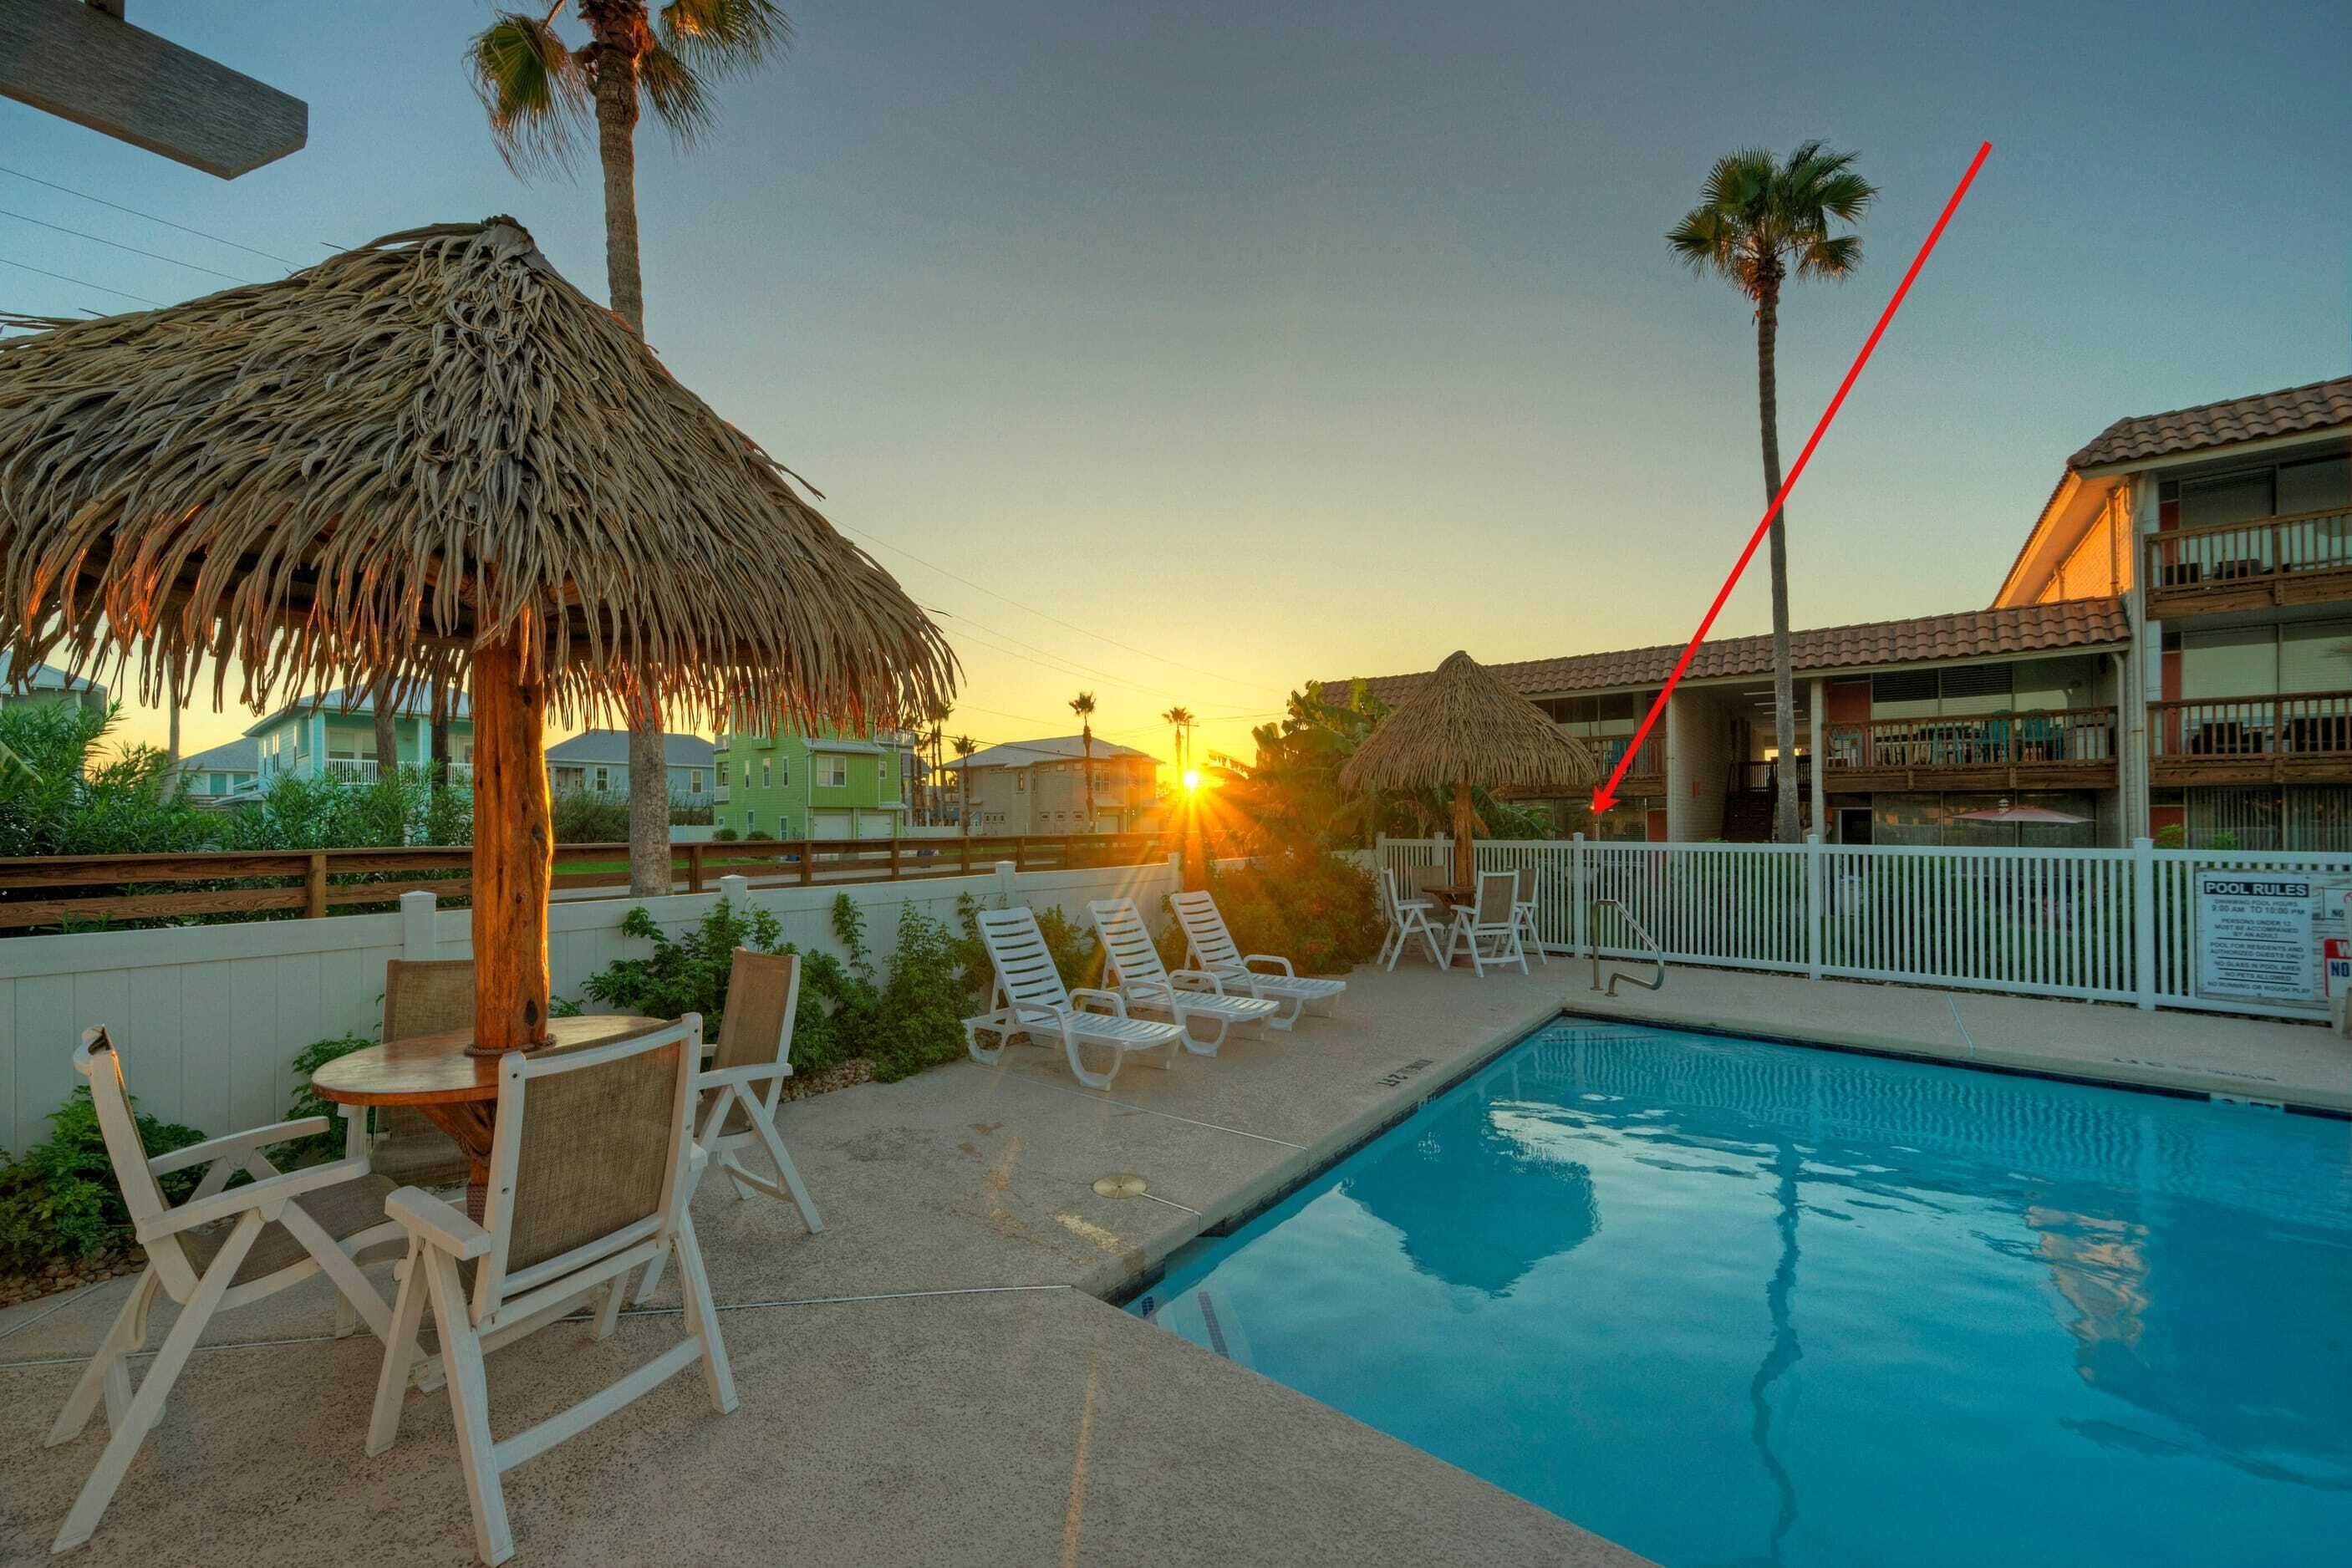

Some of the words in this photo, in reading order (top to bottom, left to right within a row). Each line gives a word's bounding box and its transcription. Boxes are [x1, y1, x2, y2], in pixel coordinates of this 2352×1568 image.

[2206, 883, 2249, 894] POOL
[2253, 883, 2307, 896] RULES
[2250, 905, 2262, 914] TO
[2330, 961, 2349, 977] NO
